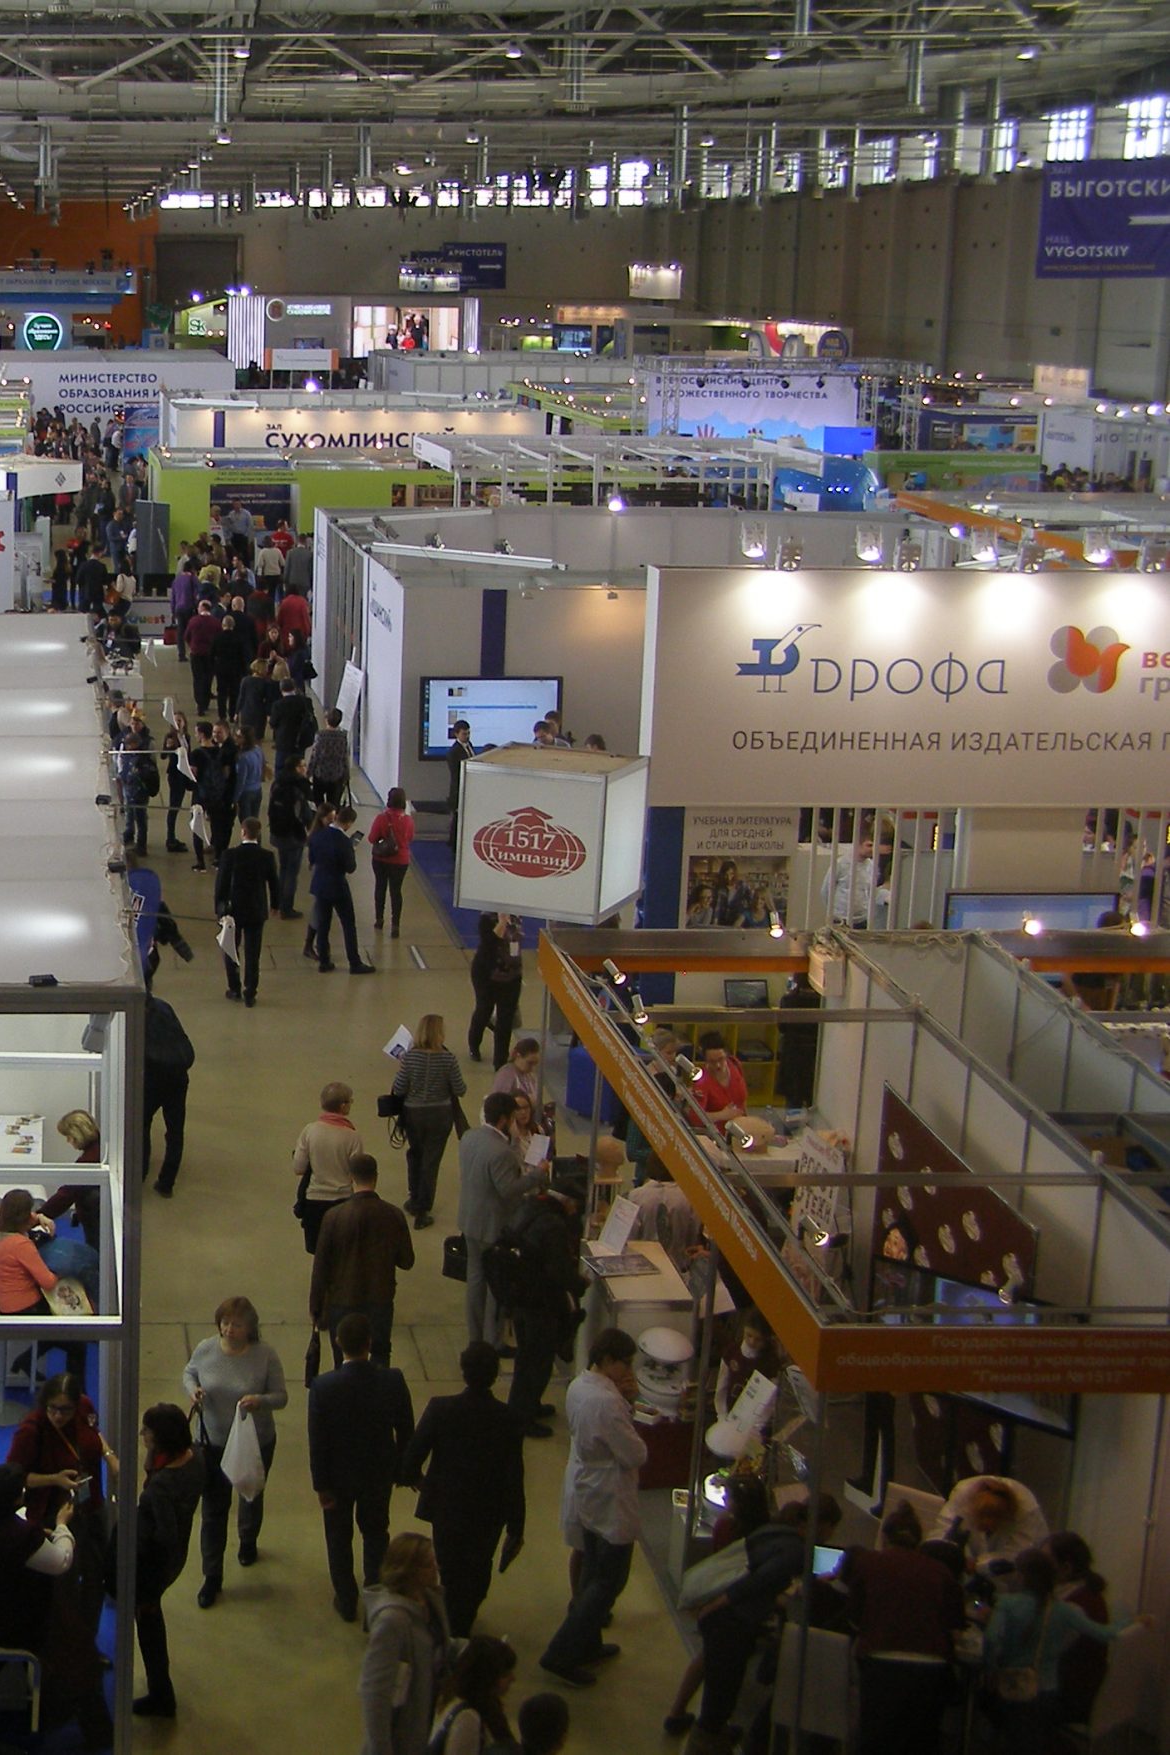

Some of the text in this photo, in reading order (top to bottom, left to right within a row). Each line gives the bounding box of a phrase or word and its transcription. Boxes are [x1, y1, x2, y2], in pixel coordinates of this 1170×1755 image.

[448, 248, 503, 257] АРИСТОТЕЛЬ
[1045, 246, 1129, 257] VYGOTSKIY
[59, 374, 158, 383] МИНИСТЕРСТВО
[750, 377, 780, 385] ЦЕНТР
[58, 389, 149, 398] ОБРАЗОВАНИЯ
[656, 390, 828, 399] ХДОЖЕСТВЕННОГО ТВОРЧЕСТВА
[59, 401, 124, 413] РОССИЙС
[265, 427, 456, 448] СУХОМЛИНС
[733, 730, 941, 754] ОБЪЕДИНЕННАЯ
[951, 731, 1152, 754] ИЗДАТЕЛЬСКАЯ
[693, 816, 792, 825] УЧЕБНАЯ ЛИТЕРАТУРА
[710, 828, 773, 839] ДЛЯ СРЕДНЕЙ
[504, 830, 556, 851] 1517
[696, 840, 784, 850] И СТАРШЕЙ ШКОЛЫ
[488, 847, 570, 868] Гимназия
[1084, 1335, 1170, 1350] бюджетно
[836, 1354, 1028, 1368] общеобразовательное
